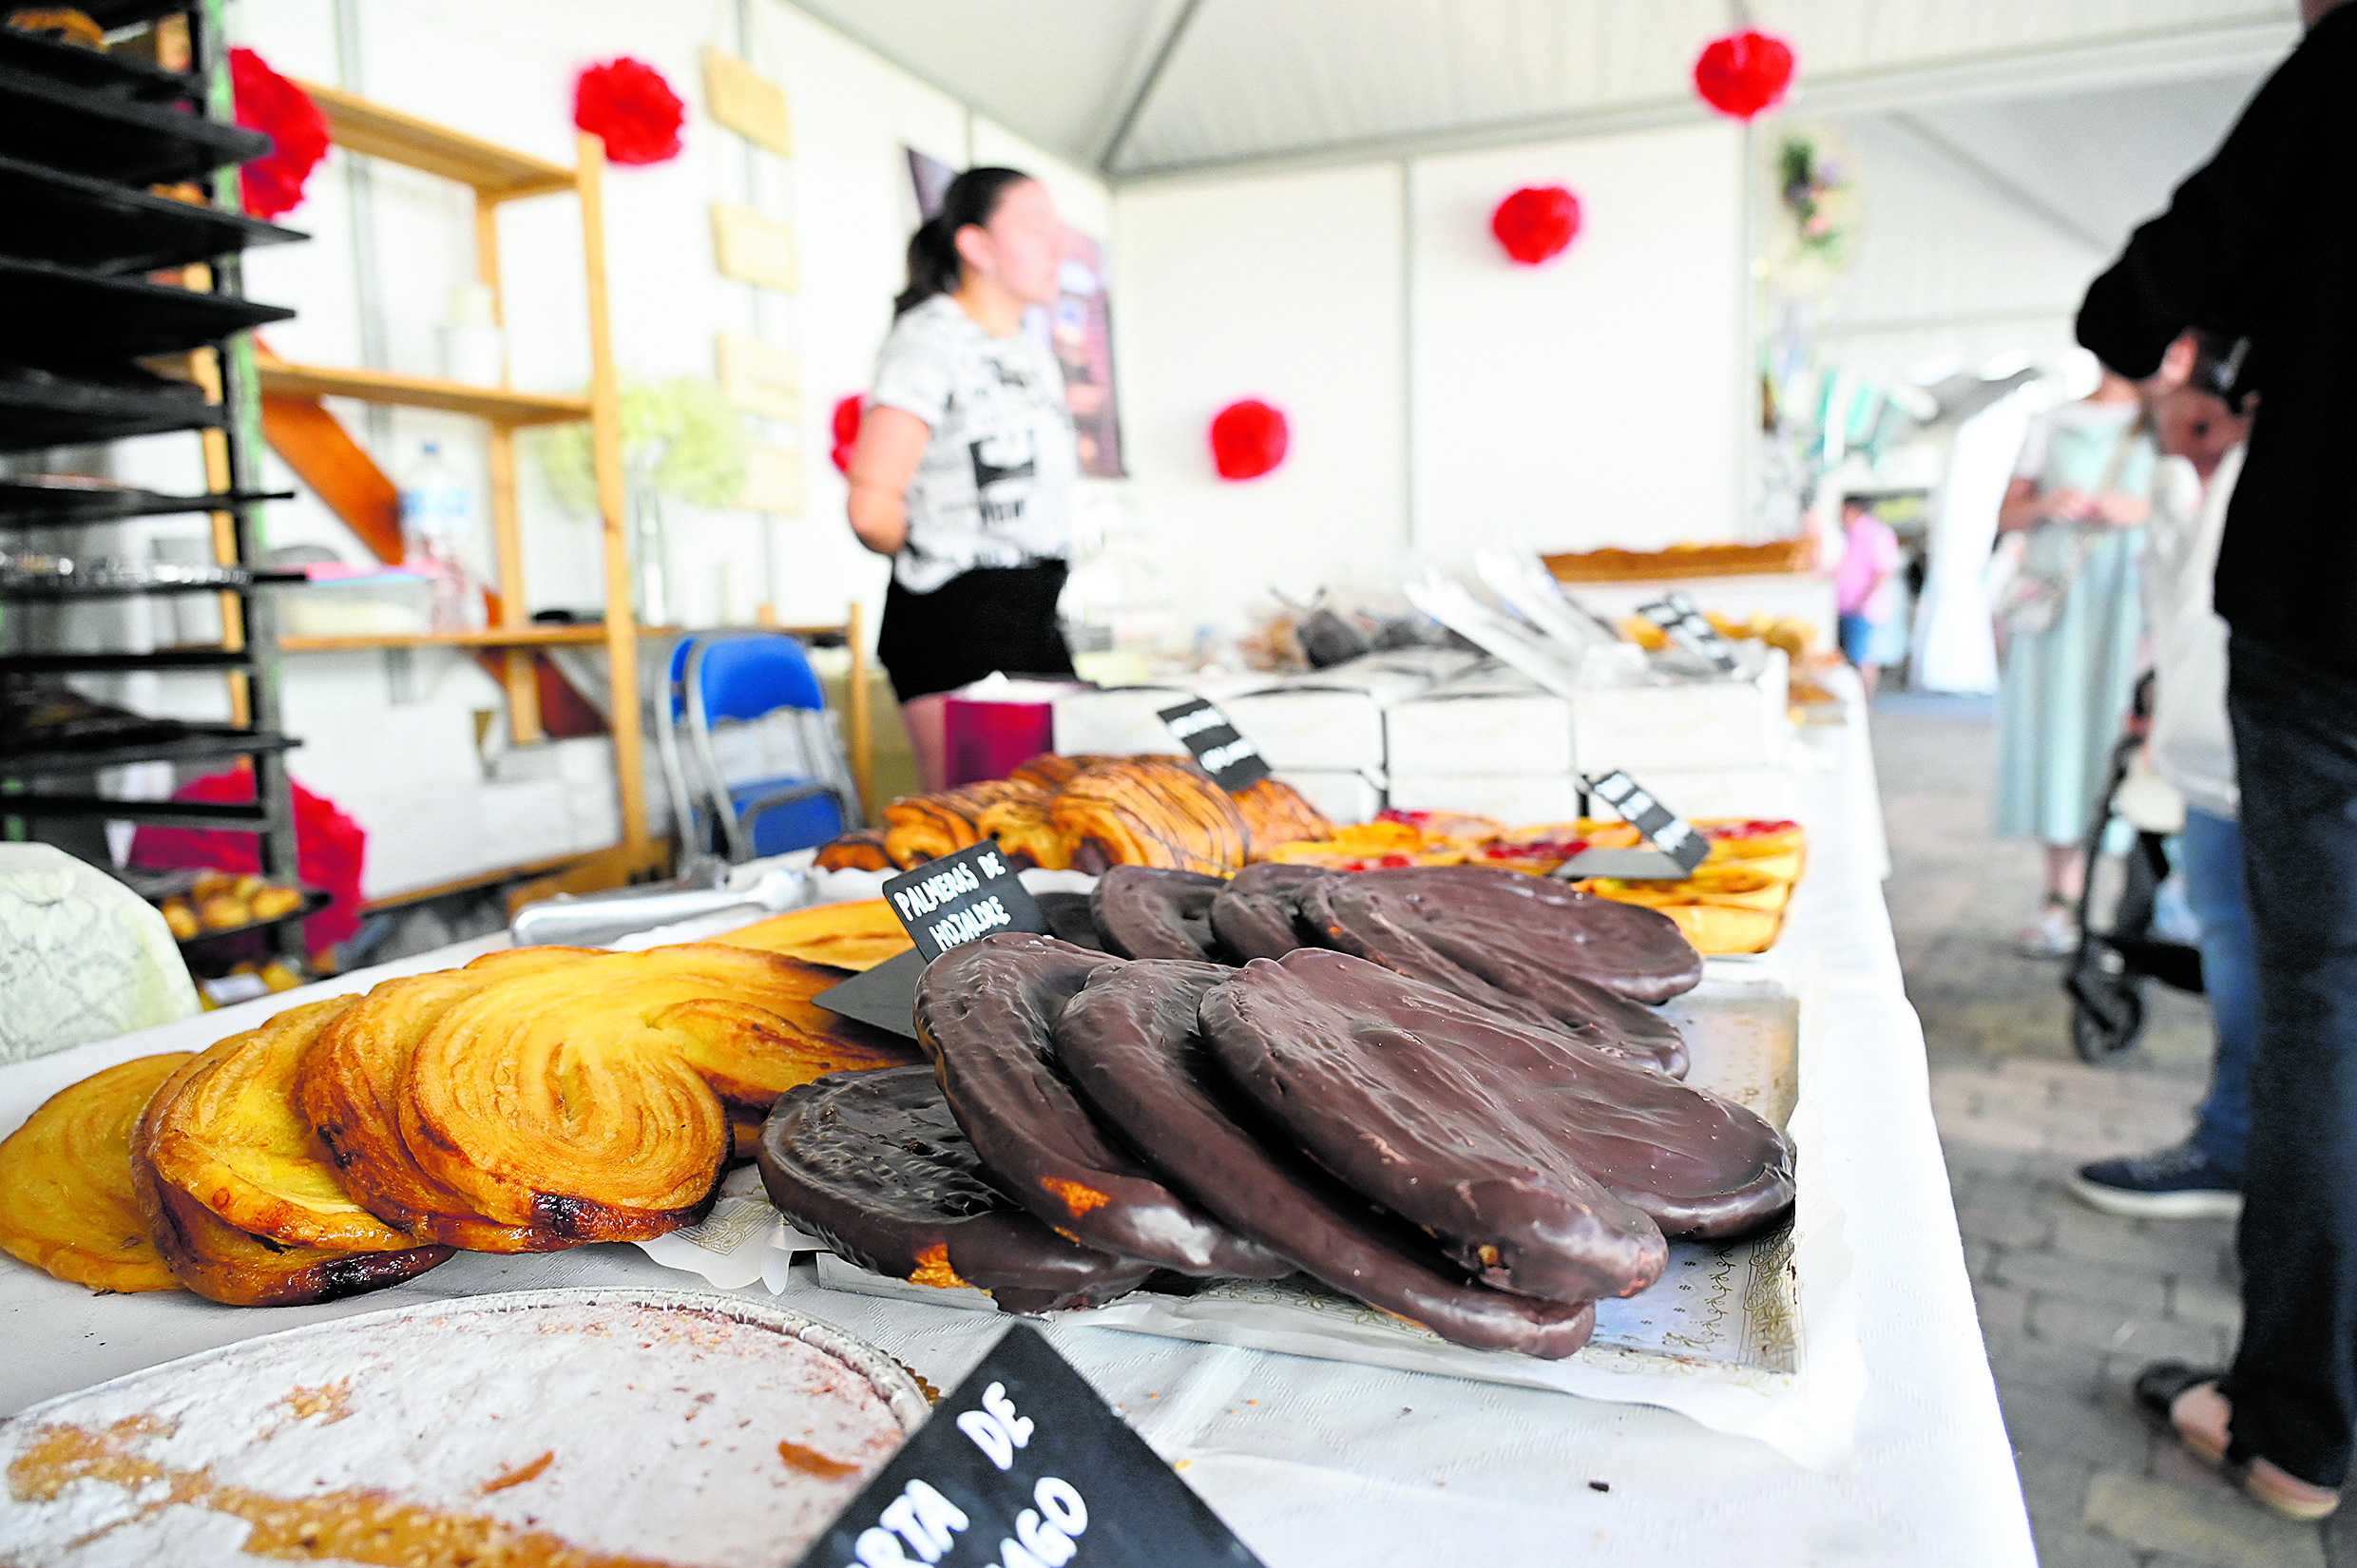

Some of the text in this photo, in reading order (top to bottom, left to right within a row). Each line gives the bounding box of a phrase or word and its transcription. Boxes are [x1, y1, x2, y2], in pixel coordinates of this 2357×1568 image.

[893, 851, 1006, 922] PALMERAS DE
[929, 895, 1011, 952] HOJALDRE
[956, 1381, 1035, 1471] DE
